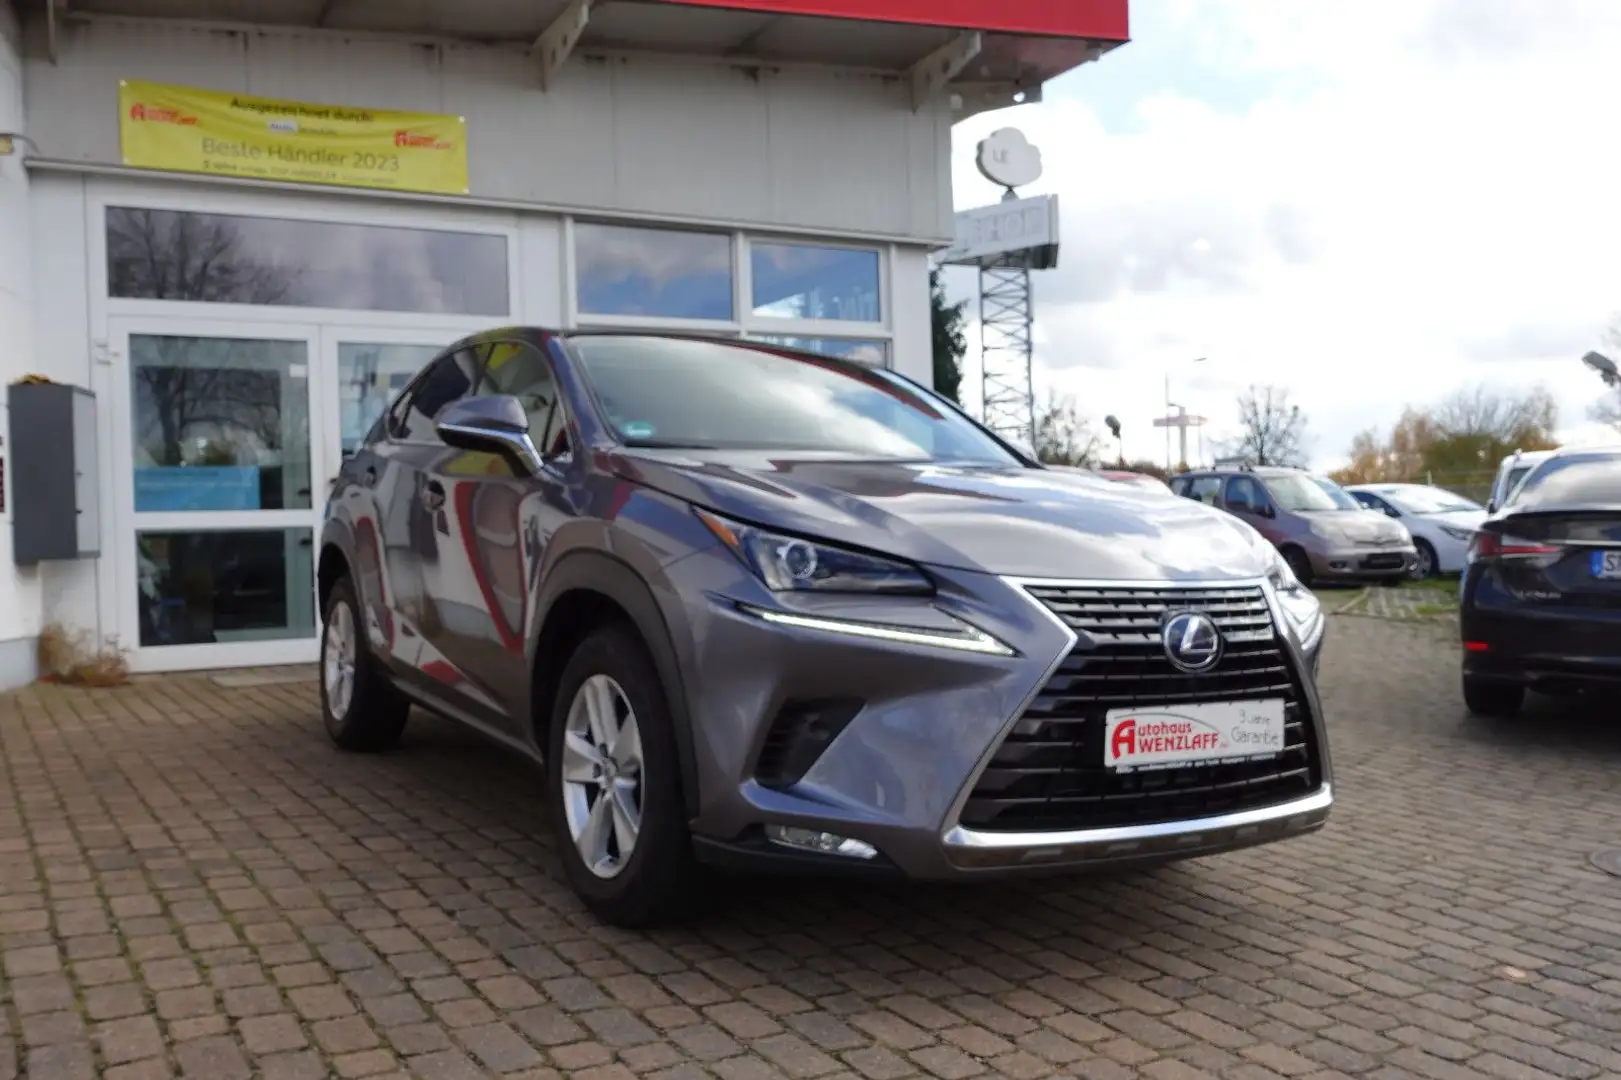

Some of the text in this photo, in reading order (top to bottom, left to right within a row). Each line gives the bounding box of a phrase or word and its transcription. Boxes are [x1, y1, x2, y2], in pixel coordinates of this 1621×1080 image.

[202, 137, 262, 160] Beste
[268, 144, 347, 166] Händler
[352, 151, 400, 172] 2023
[1605, 554, 1621, 573] S
[1138, 732, 1219, 754] WENZLAFF
[1230, 725, 1279, 746] Garantie
